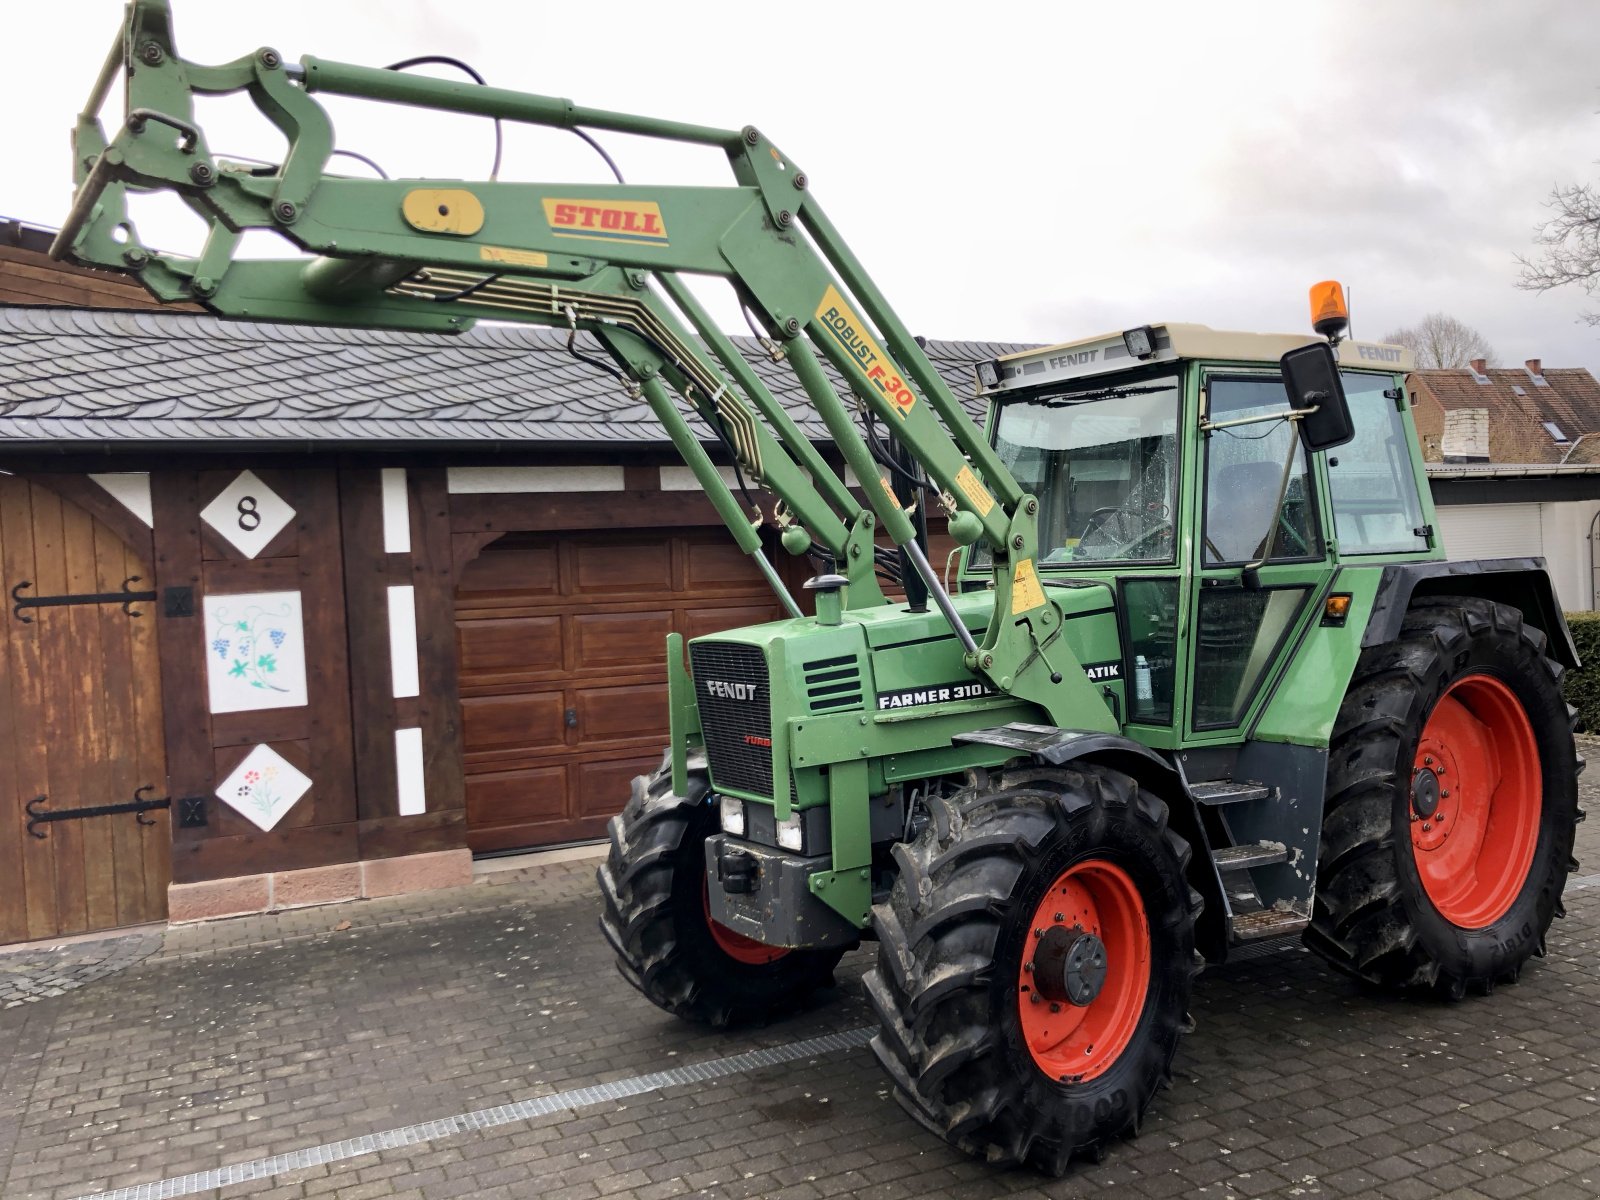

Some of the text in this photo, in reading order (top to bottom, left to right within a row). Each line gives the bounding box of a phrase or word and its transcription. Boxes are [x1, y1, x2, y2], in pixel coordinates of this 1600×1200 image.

[554, 204, 661, 234] STOLL
[825, 306, 878, 365] ROBUST
[1049, 349, 1098, 370] FENDT
[1357, 345, 1402, 363] FENDT
[237, 495, 262, 532] 8
[1086, 664, 1119, 679] ATIK
[705, 680, 757, 701] FENDT
[879, 688, 951, 709] FARMER
[953, 683, 982, 699] 310
[743, 735, 772, 747] TURB
